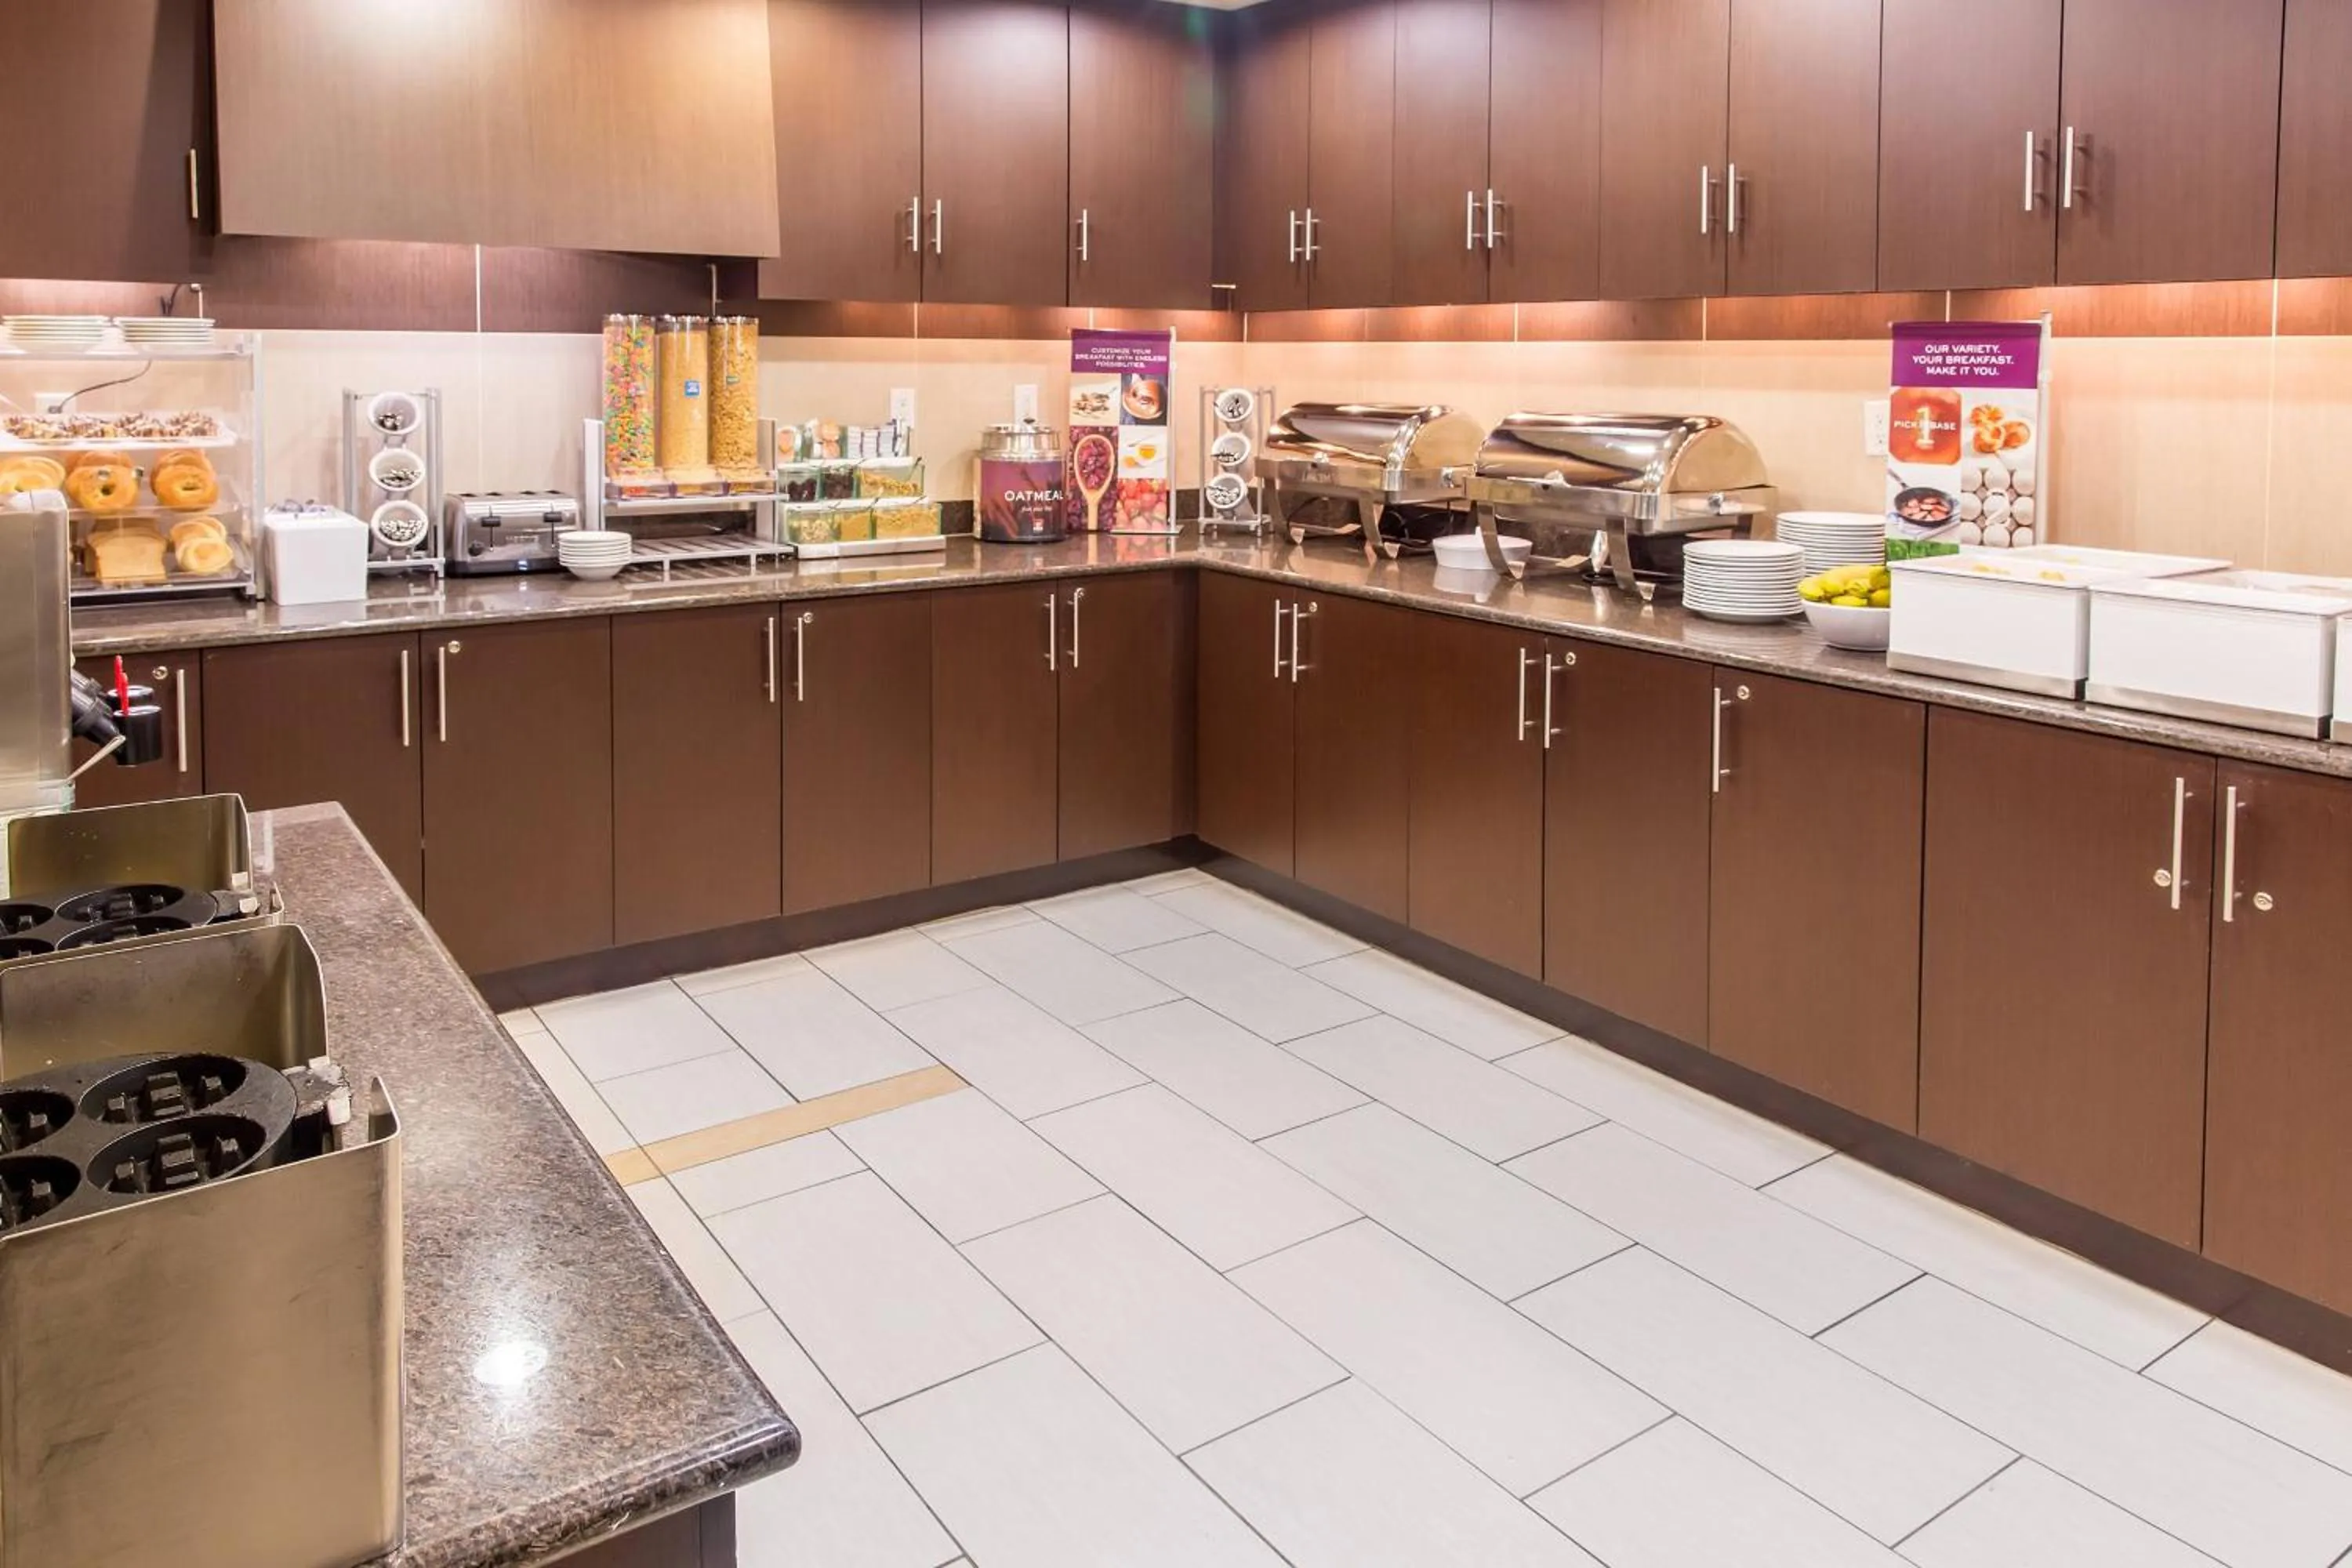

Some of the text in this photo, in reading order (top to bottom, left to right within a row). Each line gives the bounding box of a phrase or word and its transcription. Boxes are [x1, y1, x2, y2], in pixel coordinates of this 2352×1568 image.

[1925, 344, 2001, 354] OUR VARIETY.
[1913, 355, 2014, 365] YOUR BREAKFAST.
[1926, 366, 1999, 376] MAKE IT YOU.
[1893, 420, 1917, 429] PICK
[1930, 421, 1957, 430] BASE
[1004, 490, 1064, 501] OATMEAL
